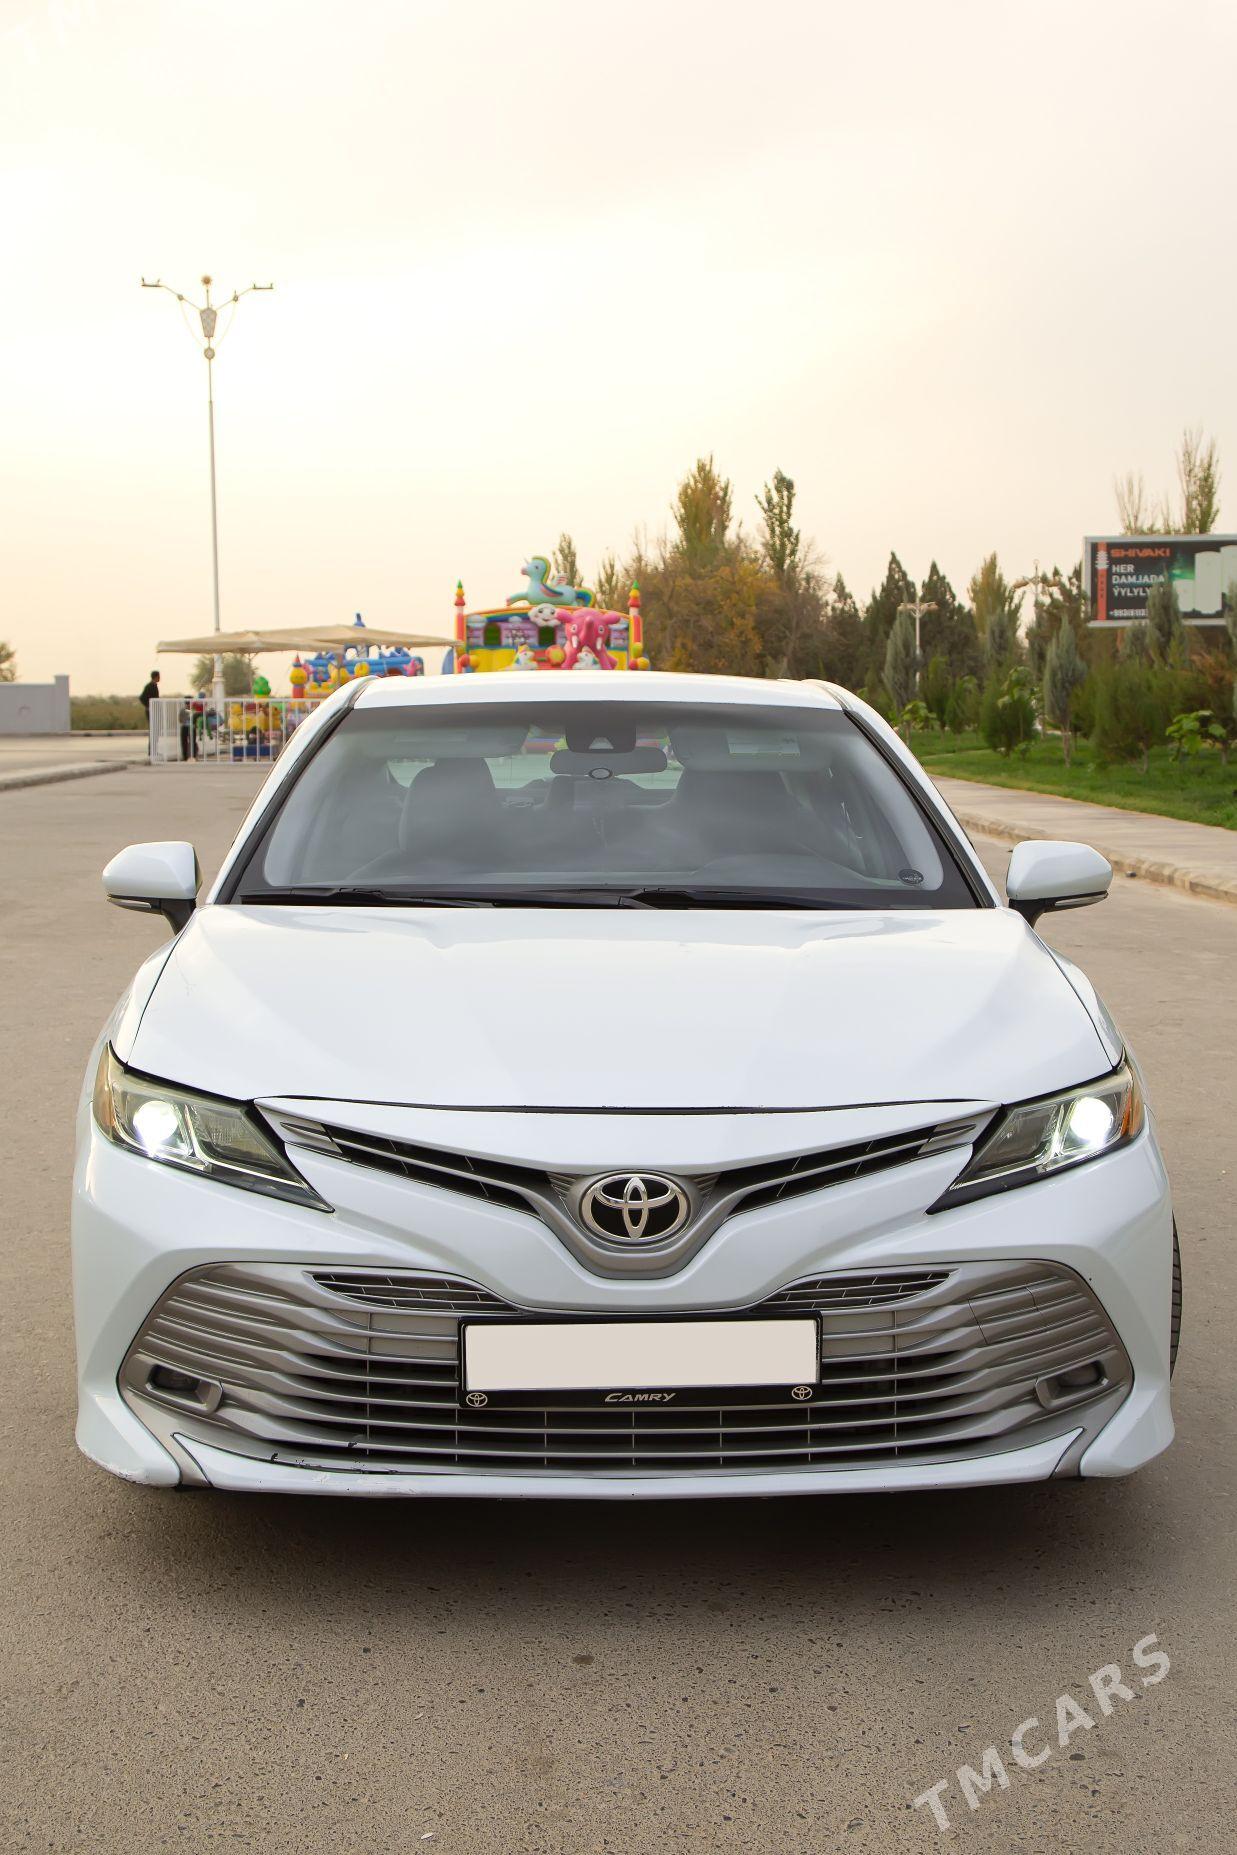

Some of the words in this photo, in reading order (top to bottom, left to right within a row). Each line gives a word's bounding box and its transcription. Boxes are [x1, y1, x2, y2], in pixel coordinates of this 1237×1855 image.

[1110, 547, 1171, 558] SHIVAKI
[1112, 564, 1135, 573] HER
[1112, 574, 1165, 584] DAMJADA
[604, 1392, 676, 1402] CAMRY
